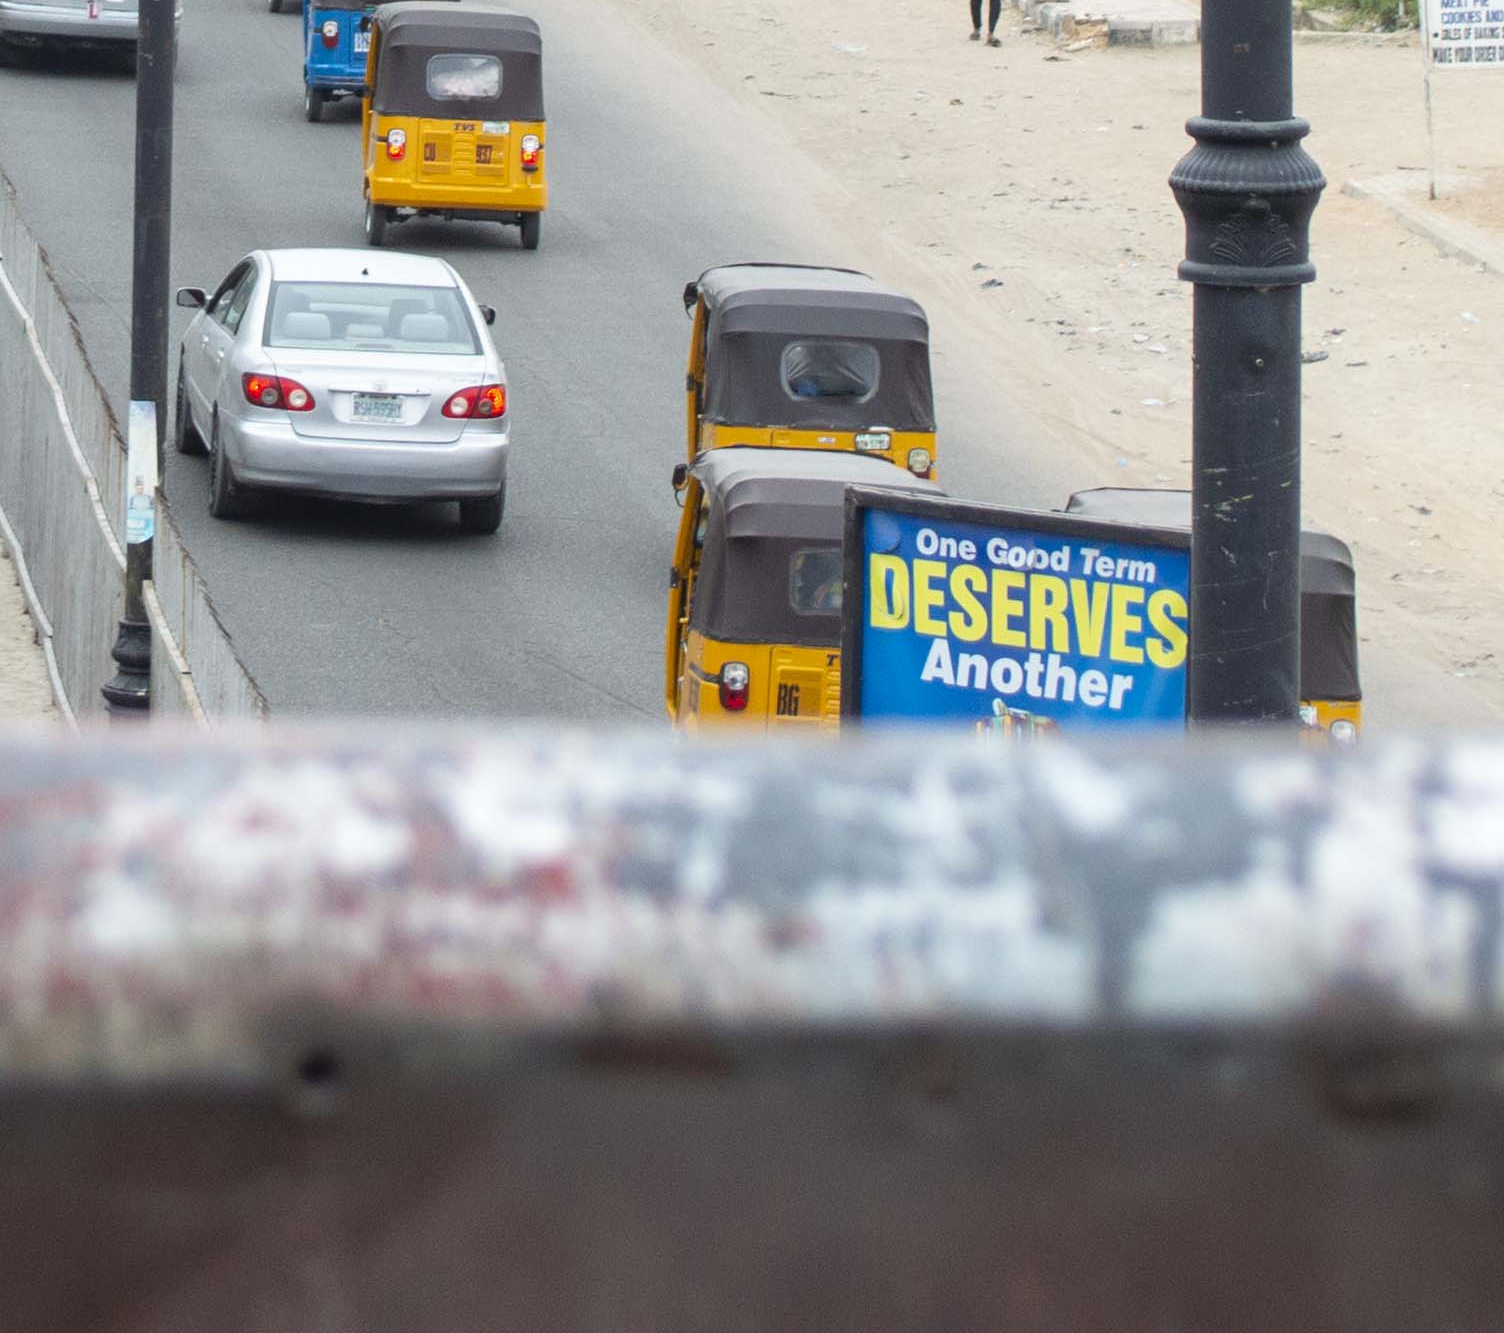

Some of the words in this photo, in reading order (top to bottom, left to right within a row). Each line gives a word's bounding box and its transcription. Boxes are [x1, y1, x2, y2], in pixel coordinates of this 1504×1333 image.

[1442, 11, 1482, 24] COOKIES
[1486, 10, 1504, 22] AND
[453, 124, 475, 132] TVS
[916, 528, 976, 561] One
[987, 538, 1070, 572] Good
[1080, 548, 1155, 582] Term
[870, 552, 1189, 669] DESERVES
[920, 638, 1133, 710] Another
